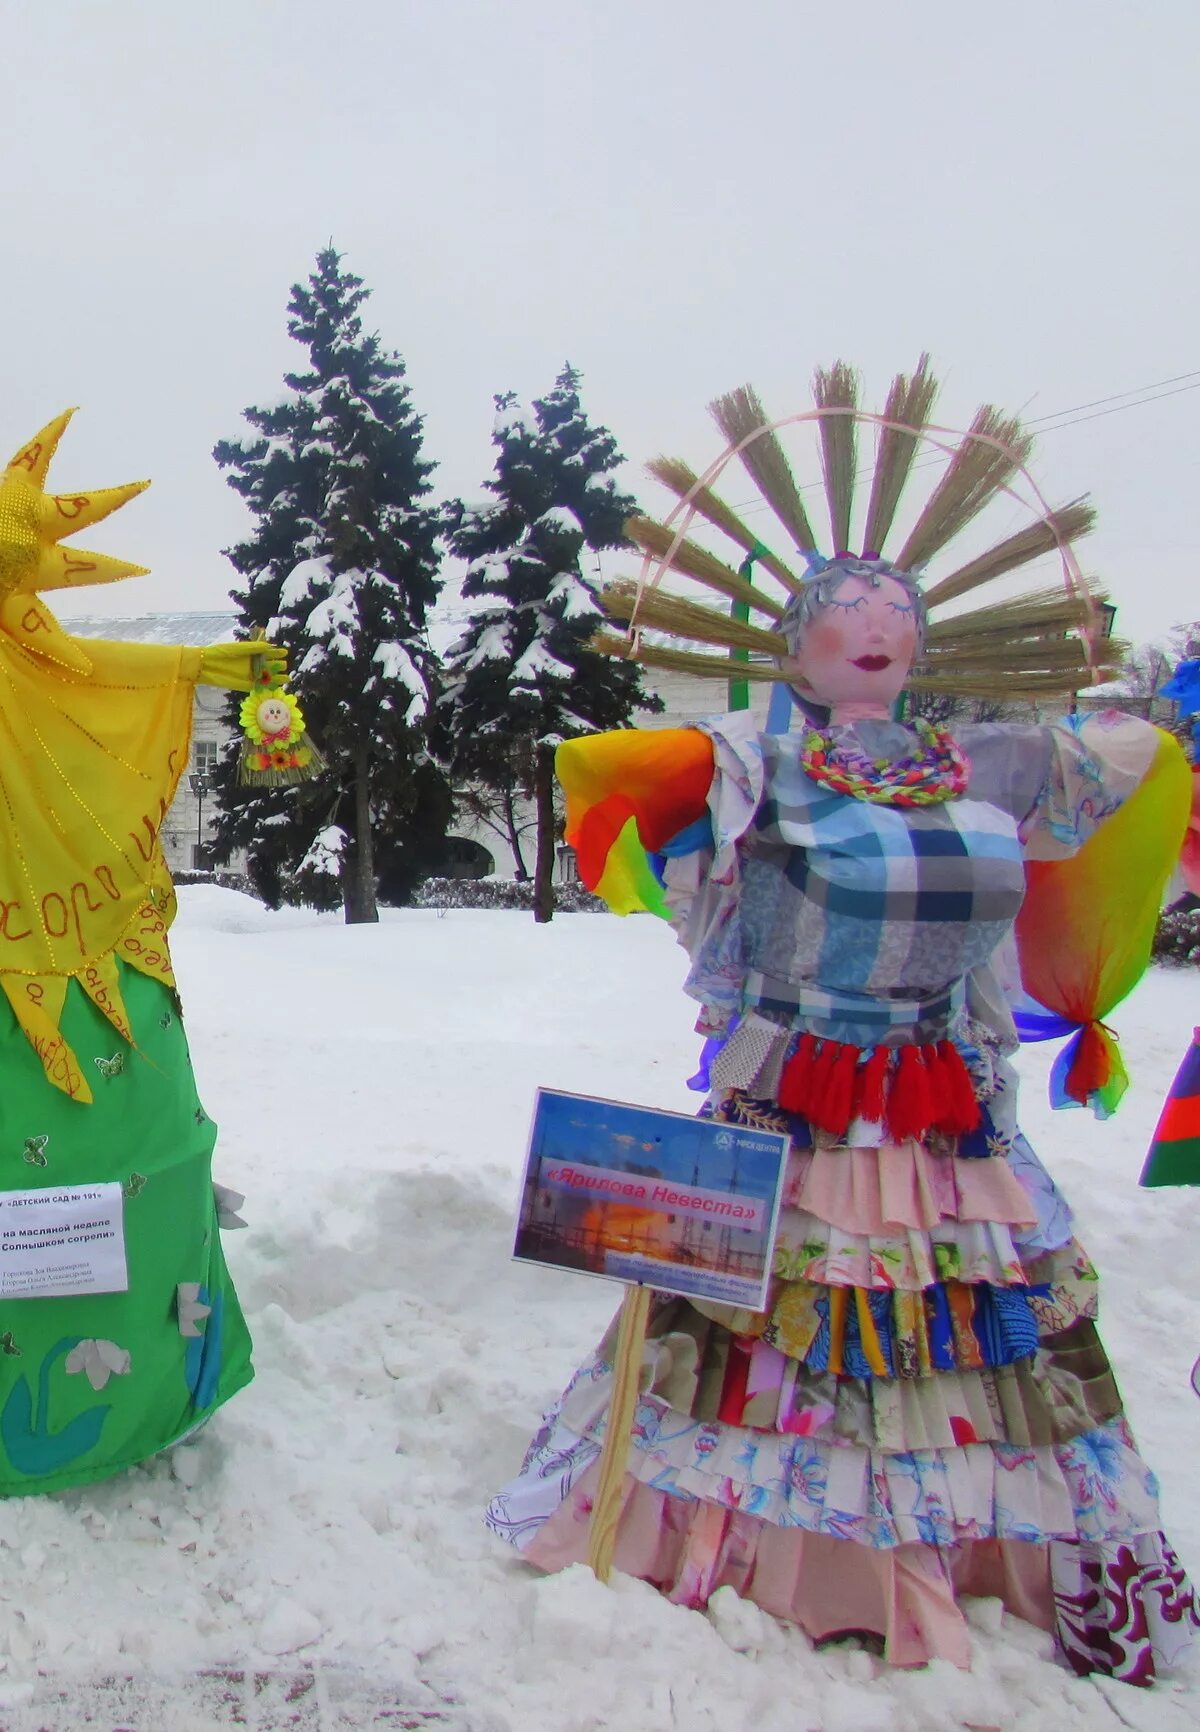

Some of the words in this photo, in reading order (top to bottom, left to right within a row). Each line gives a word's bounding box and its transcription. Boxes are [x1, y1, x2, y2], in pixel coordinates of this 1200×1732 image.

[52, 1195, 70, 1204] САД
[547, 1167, 647, 1199] «Ярилова
[652, 1185, 757, 1221] Невеста»
[4, 1230, 16, 1238] на
[19, 1223, 71, 1237] масляной
[73, 1219, 111, 1231] неделе
[2, 1238, 65, 1252] Солнышком
[67, 1231, 115, 1244] согрели»
